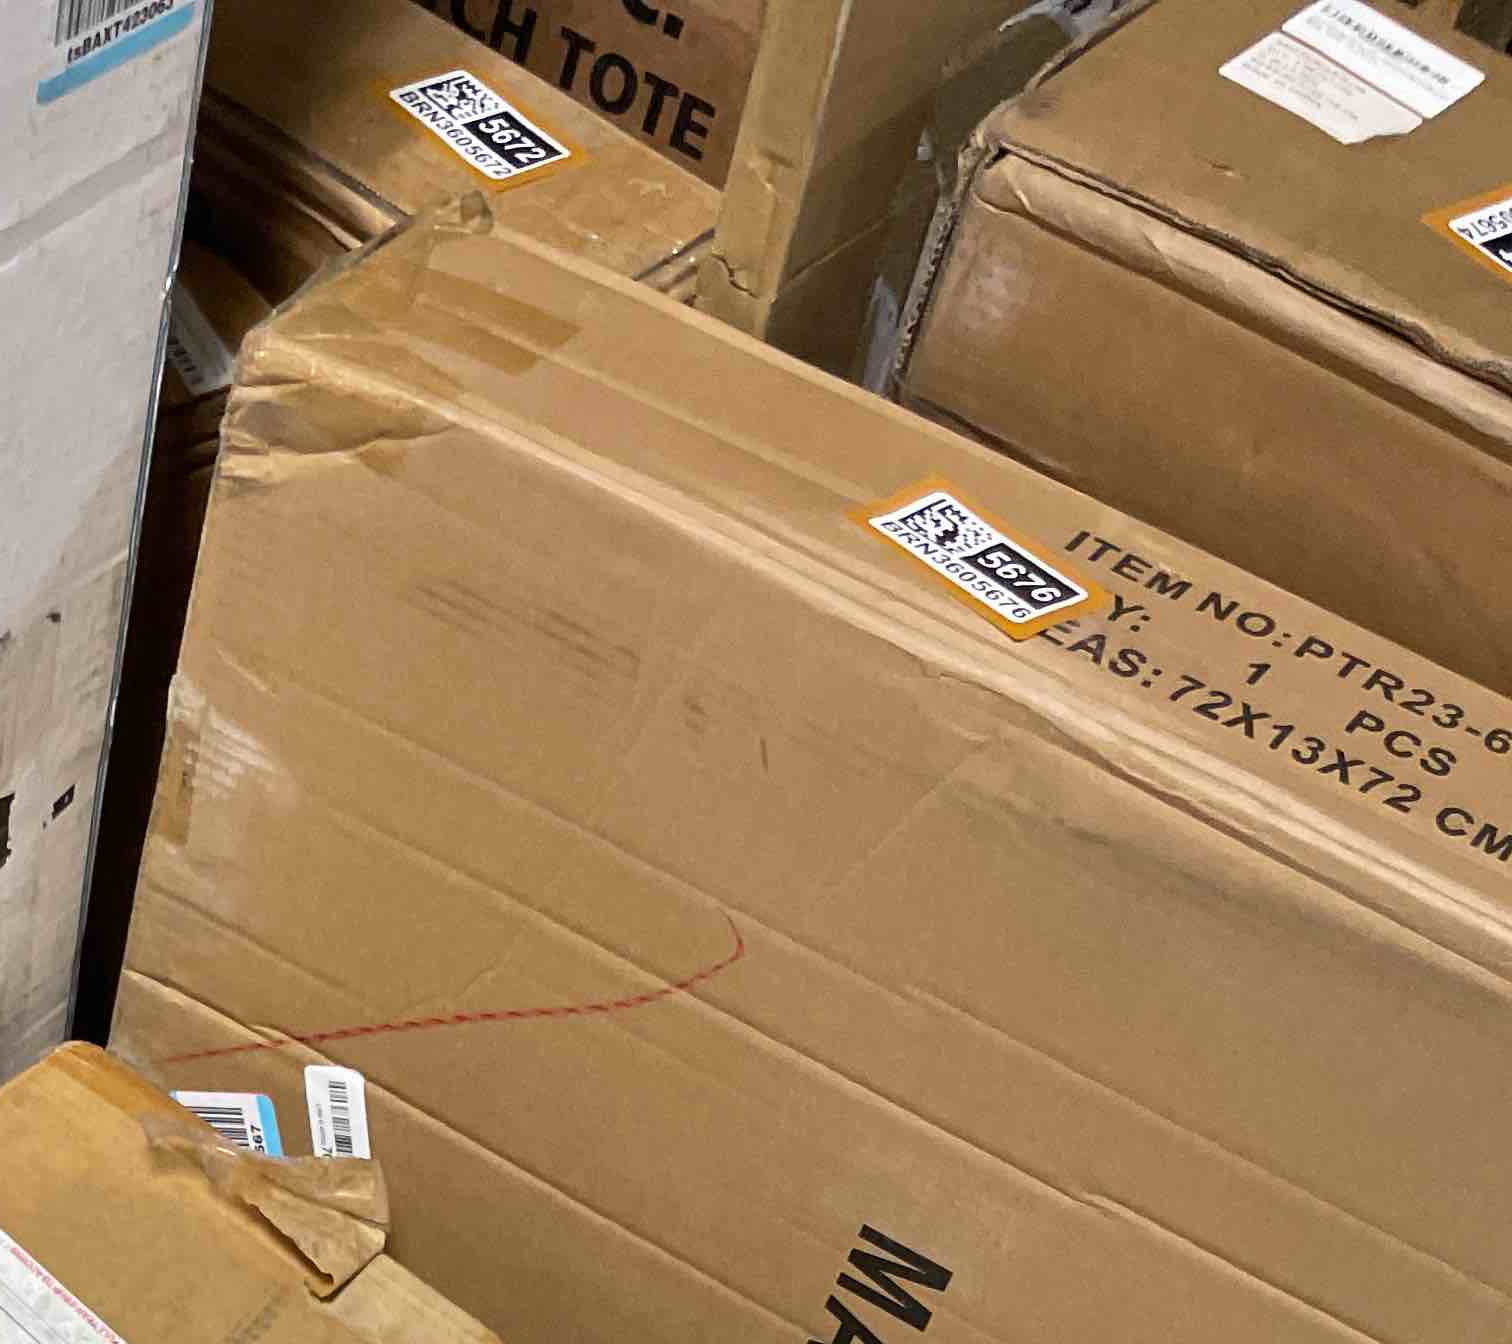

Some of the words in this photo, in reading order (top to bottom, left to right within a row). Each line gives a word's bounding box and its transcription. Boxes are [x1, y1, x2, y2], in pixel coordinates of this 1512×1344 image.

[399, 90, 513, 178] BRN3605672
[555, 26, 715, 161] TOTE
[477, 116, 548, 166] 5672
[880, 520, 1032, 619] BRN3605676
[976, 550, 1062, 603] 5676
[1064, 530, 1193, 602] ITEM
[1037, 619, 1163, 689] EAS:
[1169, 675, 1422, 814] 72X13X72
[1435, 806, 1512, 863] CM
[1242, 662, 1272, 686] 1
[1344, 709, 1458, 778] PCS
